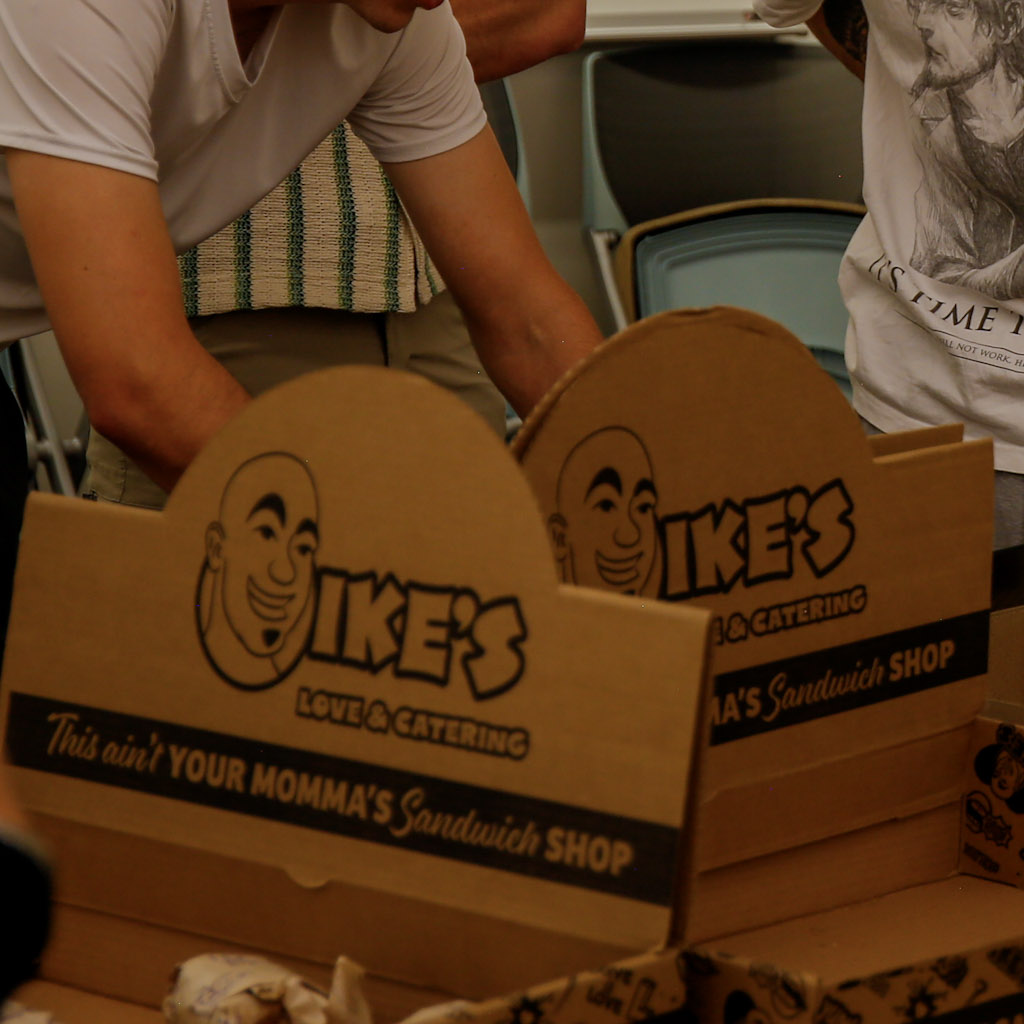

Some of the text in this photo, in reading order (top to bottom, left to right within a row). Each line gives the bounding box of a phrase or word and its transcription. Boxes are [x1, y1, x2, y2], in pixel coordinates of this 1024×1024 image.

[956, 342, 978, 354] NOT
[660, 478, 856, 601] IKE'S
[307, 566, 530, 701] IKE'S
[750, 584, 868, 638] CATERING
[763, 664, 885, 723] Sandwich
[887, 640, 956, 684] SHOP
[296, 686, 531, 761] LOVE & CATERING
[45, 710, 636, 877] This ain't YOUR MOMMA'S Sandwich SHOP
